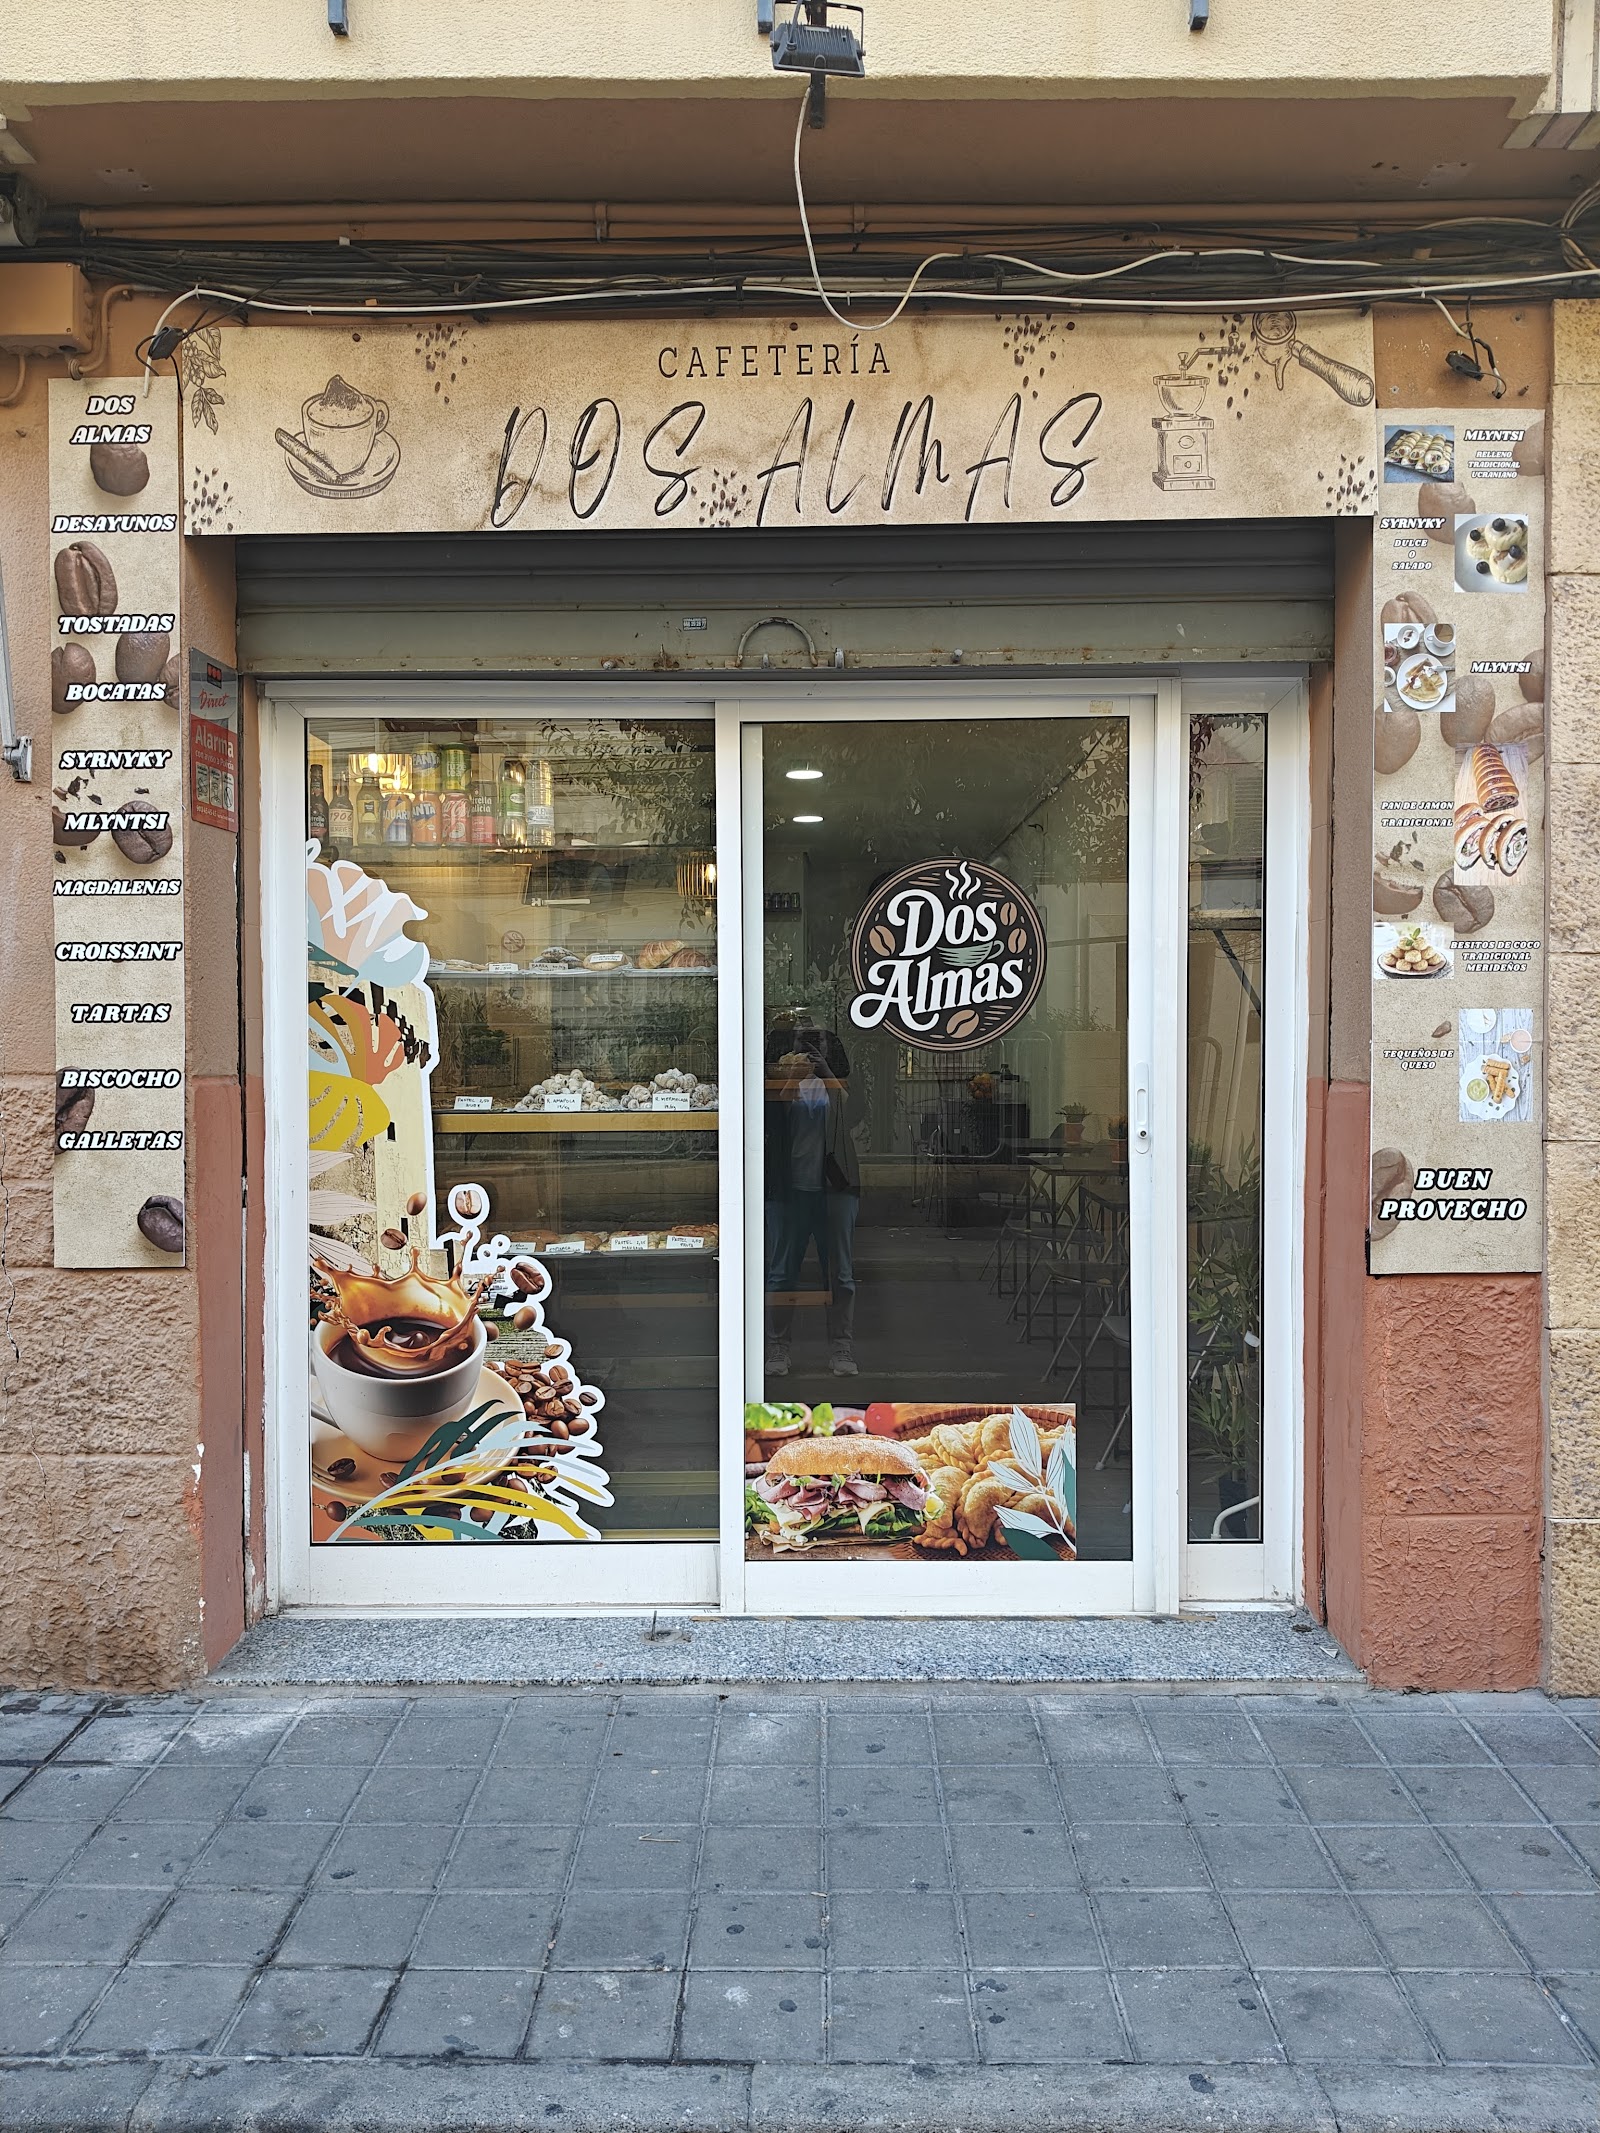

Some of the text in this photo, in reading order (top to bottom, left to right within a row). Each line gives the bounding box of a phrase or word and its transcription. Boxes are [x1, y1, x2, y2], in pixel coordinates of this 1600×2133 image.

[657, 333, 891, 379] CAFETERÍA
[86, 395, 136, 414] DOS
[70, 424, 152, 445] ALMAS
[1464, 429, 1525, 442] MLYNTSI
[490, 392, 1104, 529] DOS ALMAS
[1475, 451, 1512, 459] RELLENO
[1468, 461, 1521, 469] TRADICIONAL
[1471, 471, 1518, 479] UCRANIANO
[52, 514, 177, 533] DESAYUNOS
[1380, 517, 1446, 530] SYRNYKY
[1394, 539, 1428, 547] DULCE
[1408, 550, 1416, 559] O
[1391, 562, 1432, 570] SALADO
[58, 614, 175, 634] TOSTADAS
[1470, 661, 1532, 674] MLYNTSI
[65, 682, 167, 702] BOCATAS
[195, 725, 234, 758] Alarma
[59, 749, 172, 770] SYRNYKY
[1381, 801, 1455, 810] PAN DE JAMON
[63, 812, 169, 832] MLYNTSI
[330, 812, 352, 822] 1906
[1381, 818, 1453, 827] TRADICIONAL
[53, 879, 182, 896] MAGDALENAS
[886, 889, 998, 957] Dos
[55, 941, 184, 962] CROISSANT
[1450, 941, 1541, 950] BESITOS DE COCO
[1461, 952, 1531, 960] TRADICIONAL
[1466, 961, 1527, 972] MERIDEÑOS
[850, 955, 1024, 1032] Almas
[71, 1003, 172, 1023] TARTAS
[1383, 1048, 1454, 1060] TEQUEÑOS DE
[1401, 1061, 1436, 1071] QUESO
[61, 1068, 182, 1089] BISCOCHO
[59, 1131, 183, 1151] GALLETAS
[1414, 1168, 1493, 1190] BUEN
[1378, 1198, 1527, 1220] PROVECHO
